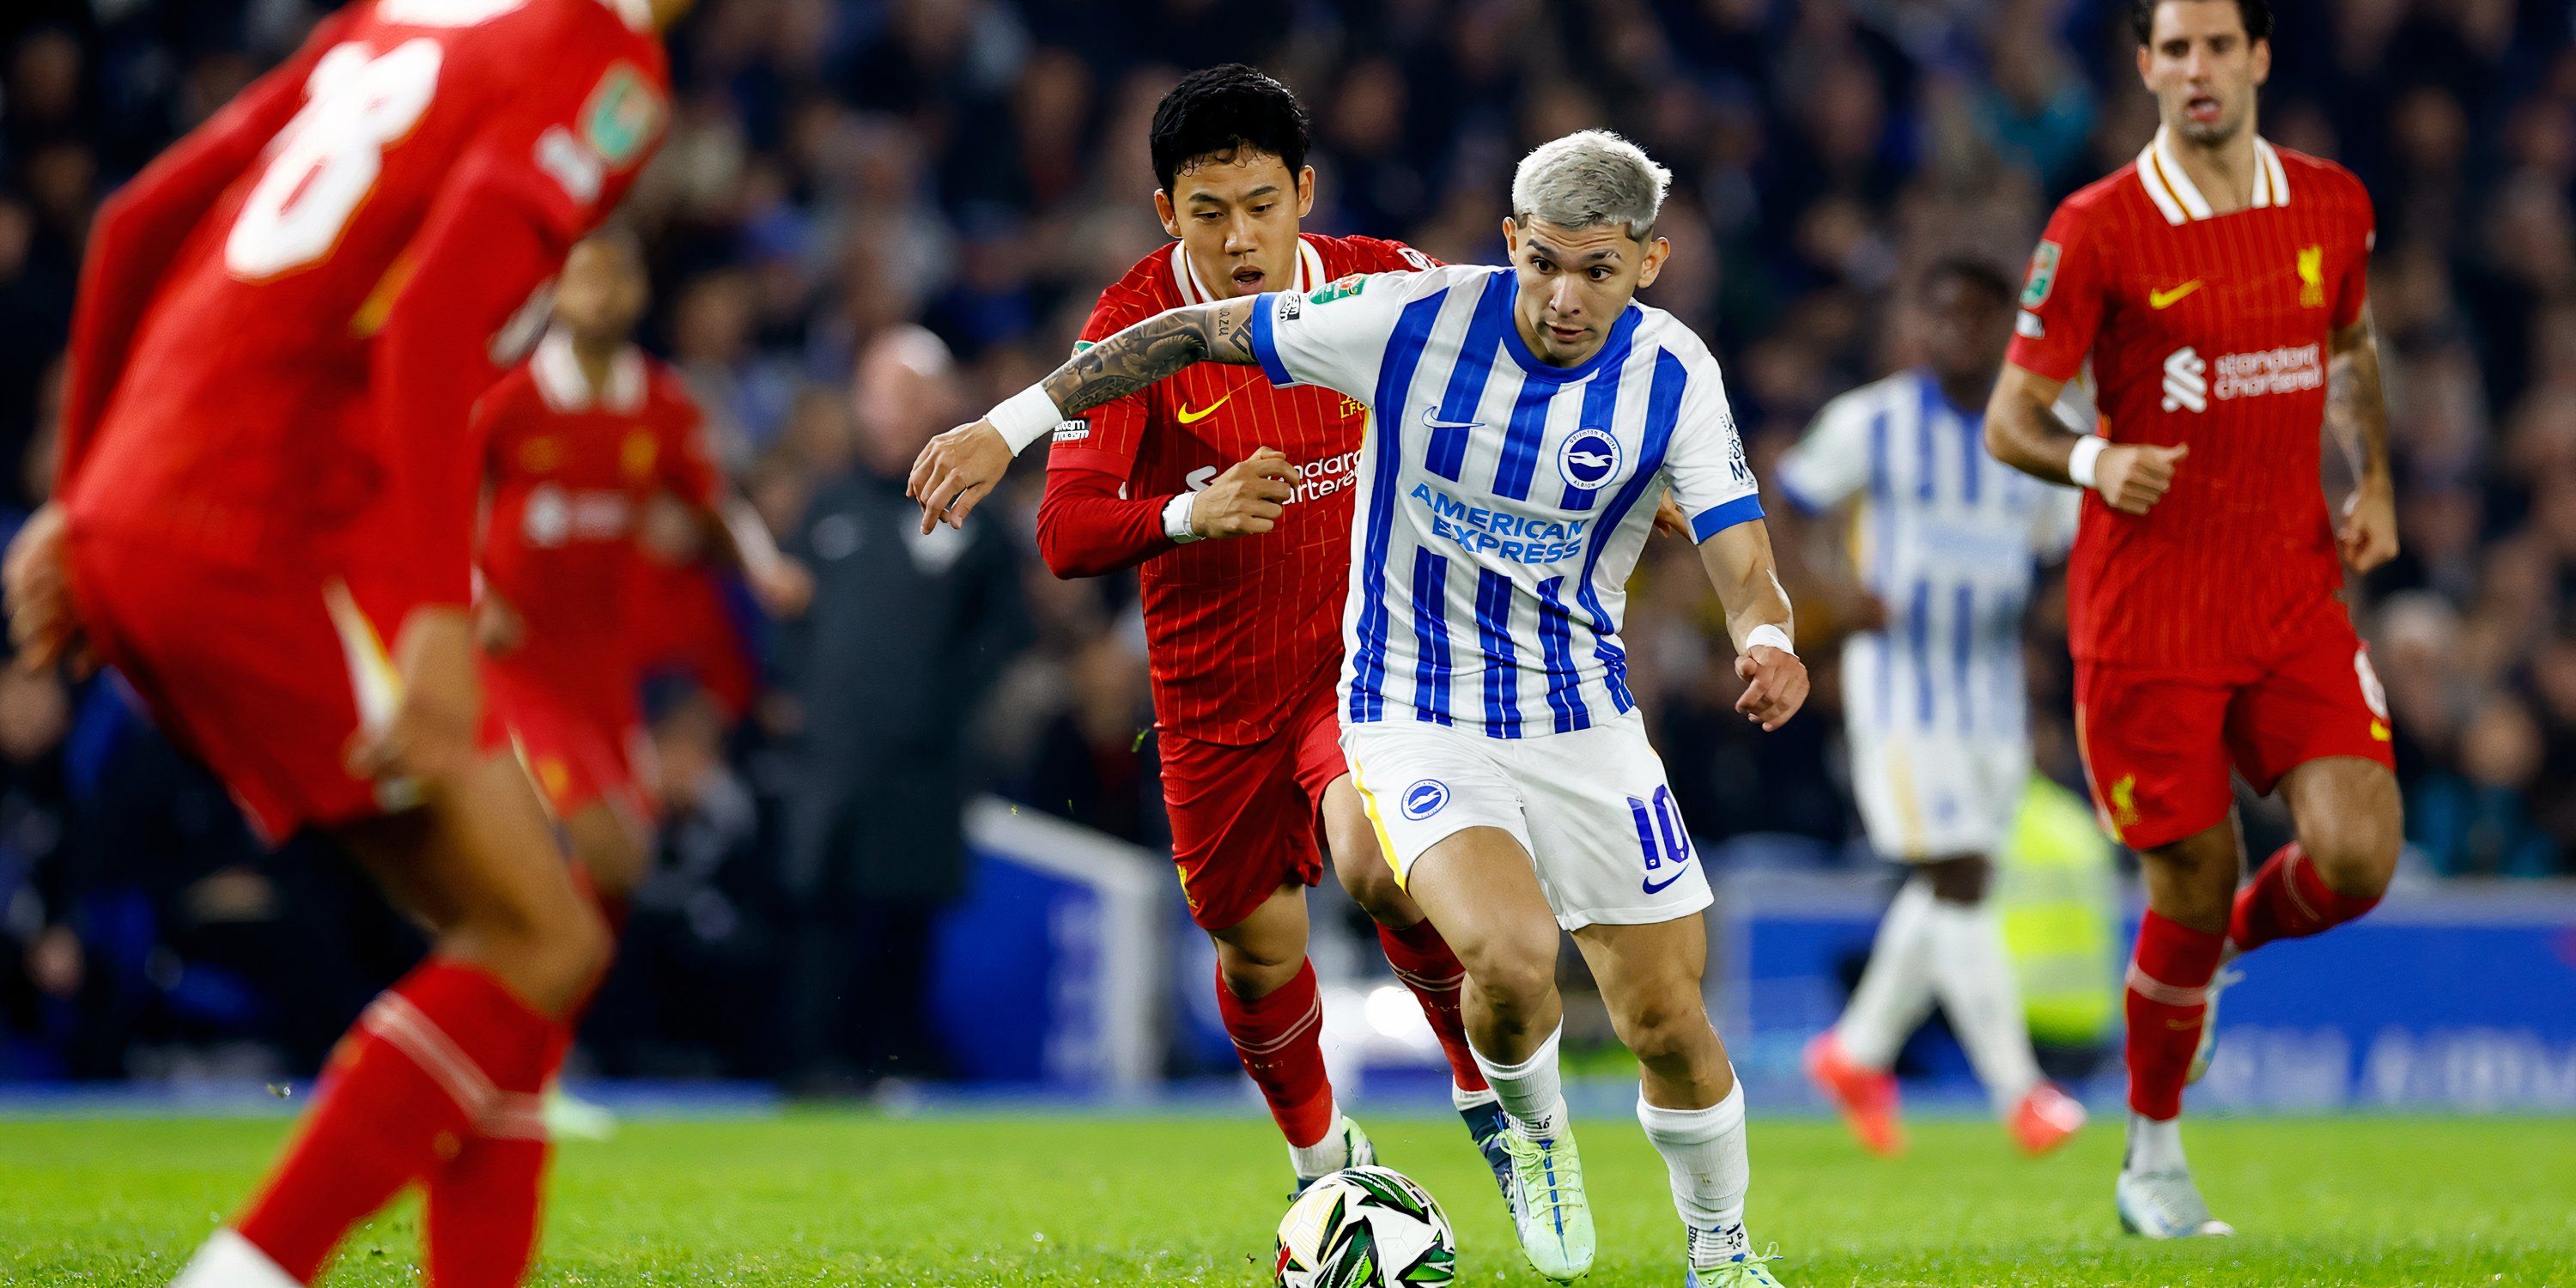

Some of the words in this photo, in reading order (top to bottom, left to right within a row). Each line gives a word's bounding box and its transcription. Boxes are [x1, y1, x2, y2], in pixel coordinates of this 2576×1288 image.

[224, 36, 444, 283] 8
[1411, 483, 1589, 540] AMERICAN
[1432, 515, 1582, 564] EXPRESS
[1626, 784, 1689, 870] 10
